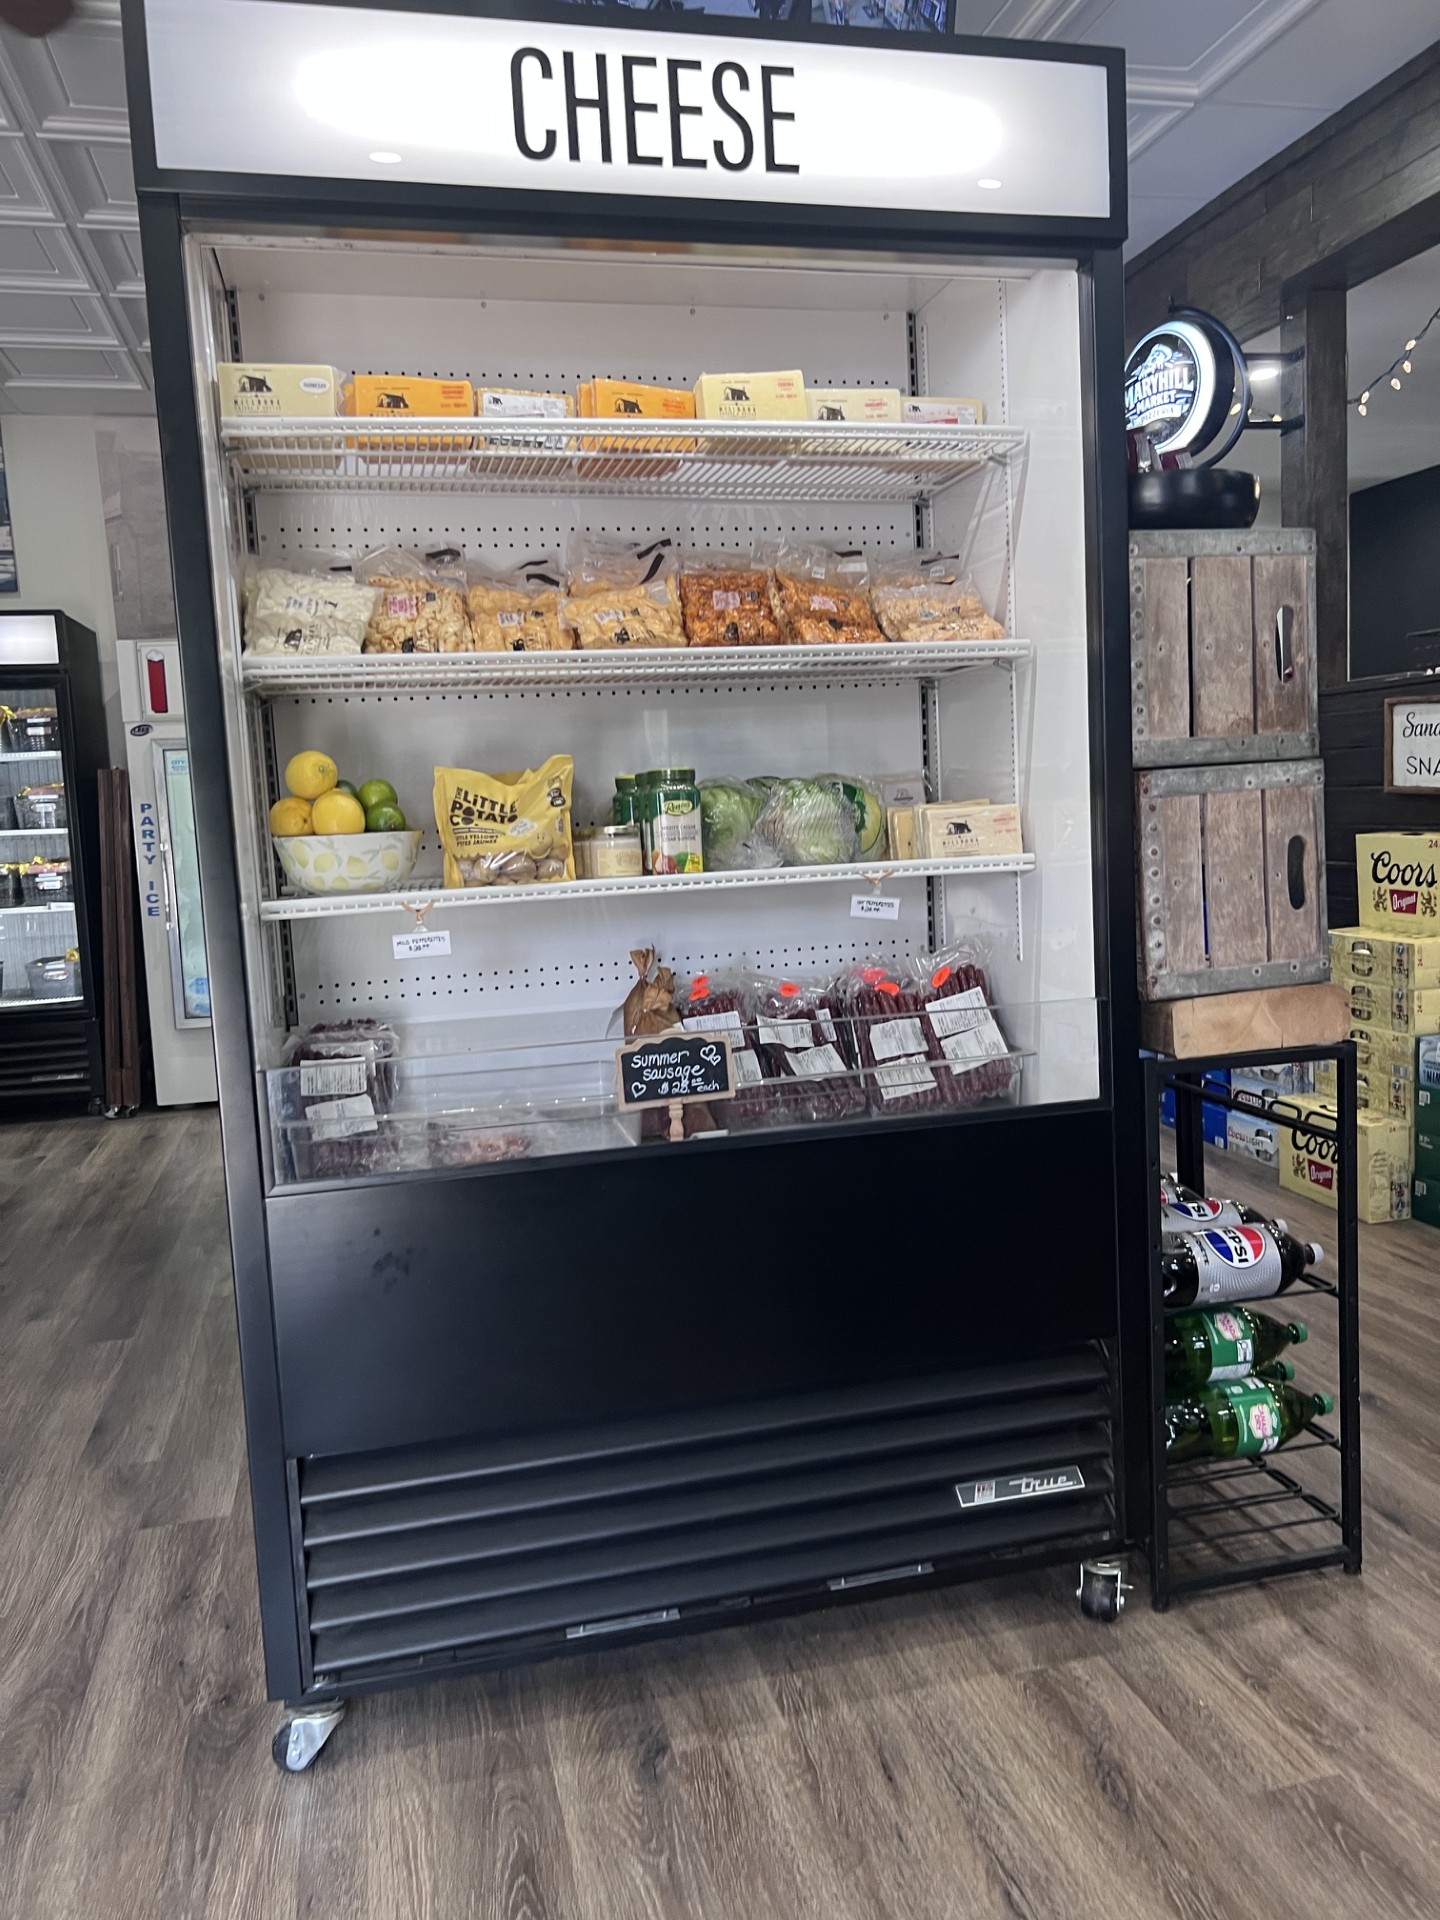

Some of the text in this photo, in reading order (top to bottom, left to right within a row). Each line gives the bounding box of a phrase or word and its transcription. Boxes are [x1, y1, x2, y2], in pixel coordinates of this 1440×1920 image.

[510, 47, 800, 174] CHEESE
[1125, 367, 1194, 411] MARYHILL
[1136, 389, 1177, 415] MARKET
[451, 800, 518, 824] POTATO
[1428, 839, 1439, 849] 24
[140, 803, 160, 917] PARTY ICE
[1371, 850, 1438, 888] Coors
[1392, 892, 1417, 912] Original
[643, 1064, 705, 1082] sausage
[697, 1080, 720, 1093] each
[1246, 1135, 1265, 1149] LIGHT
[1292, 1125, 1338, 1164] Coo
[1222, 1228, 1249, 1264] EPSI
